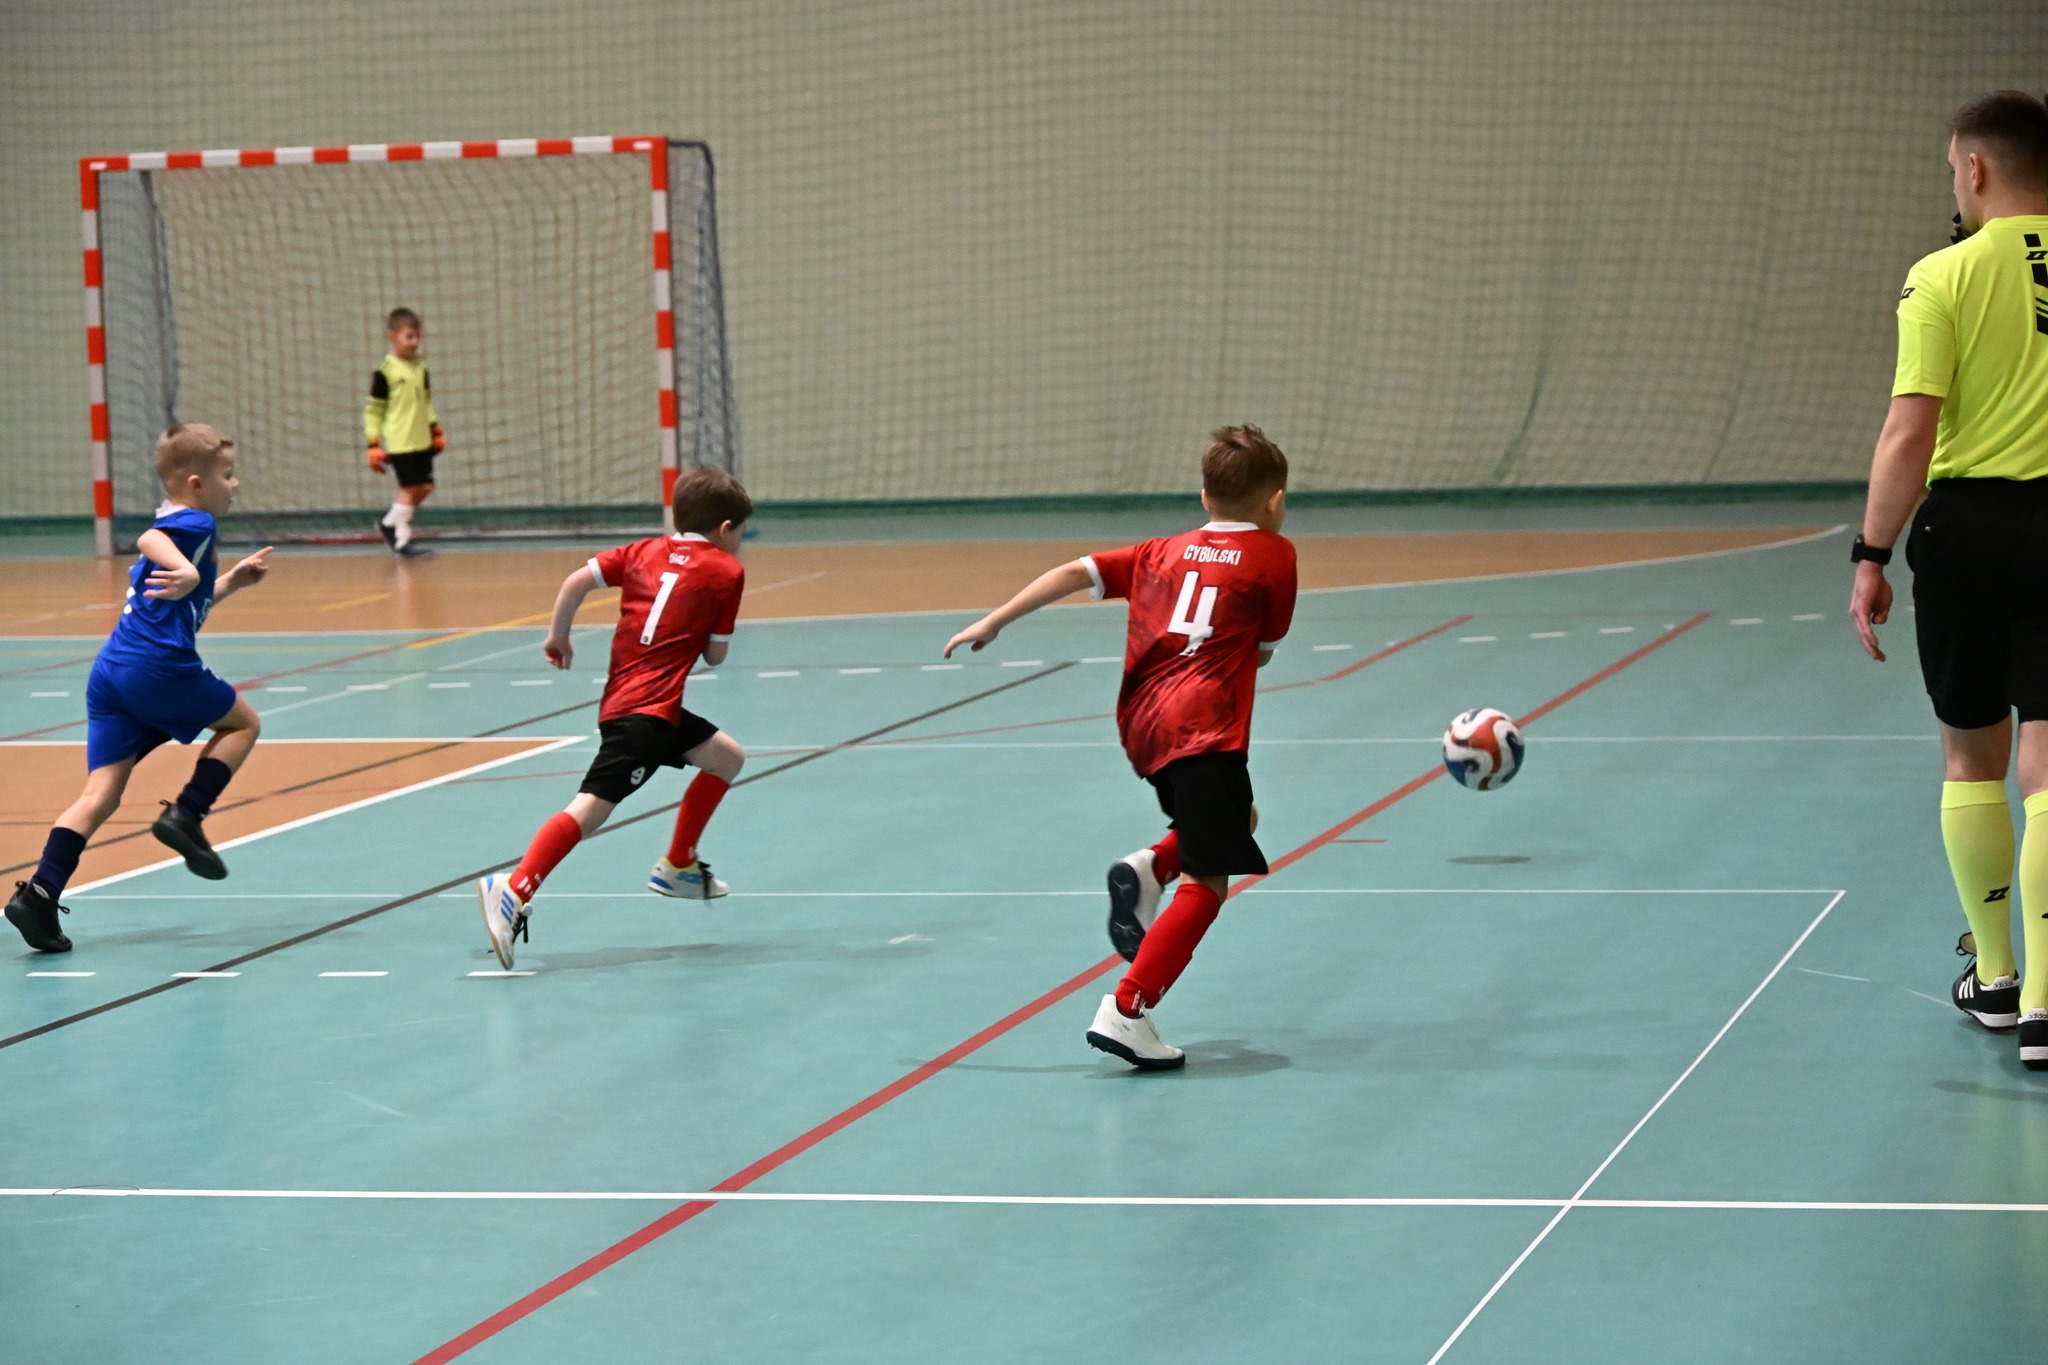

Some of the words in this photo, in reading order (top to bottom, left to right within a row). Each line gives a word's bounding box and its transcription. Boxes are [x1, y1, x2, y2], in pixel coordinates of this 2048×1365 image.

[1183, 544, 1242, 566] CYBULSKI
[640, 571, 680, 646] 1
[1167, 570, 1219, 657] 4
